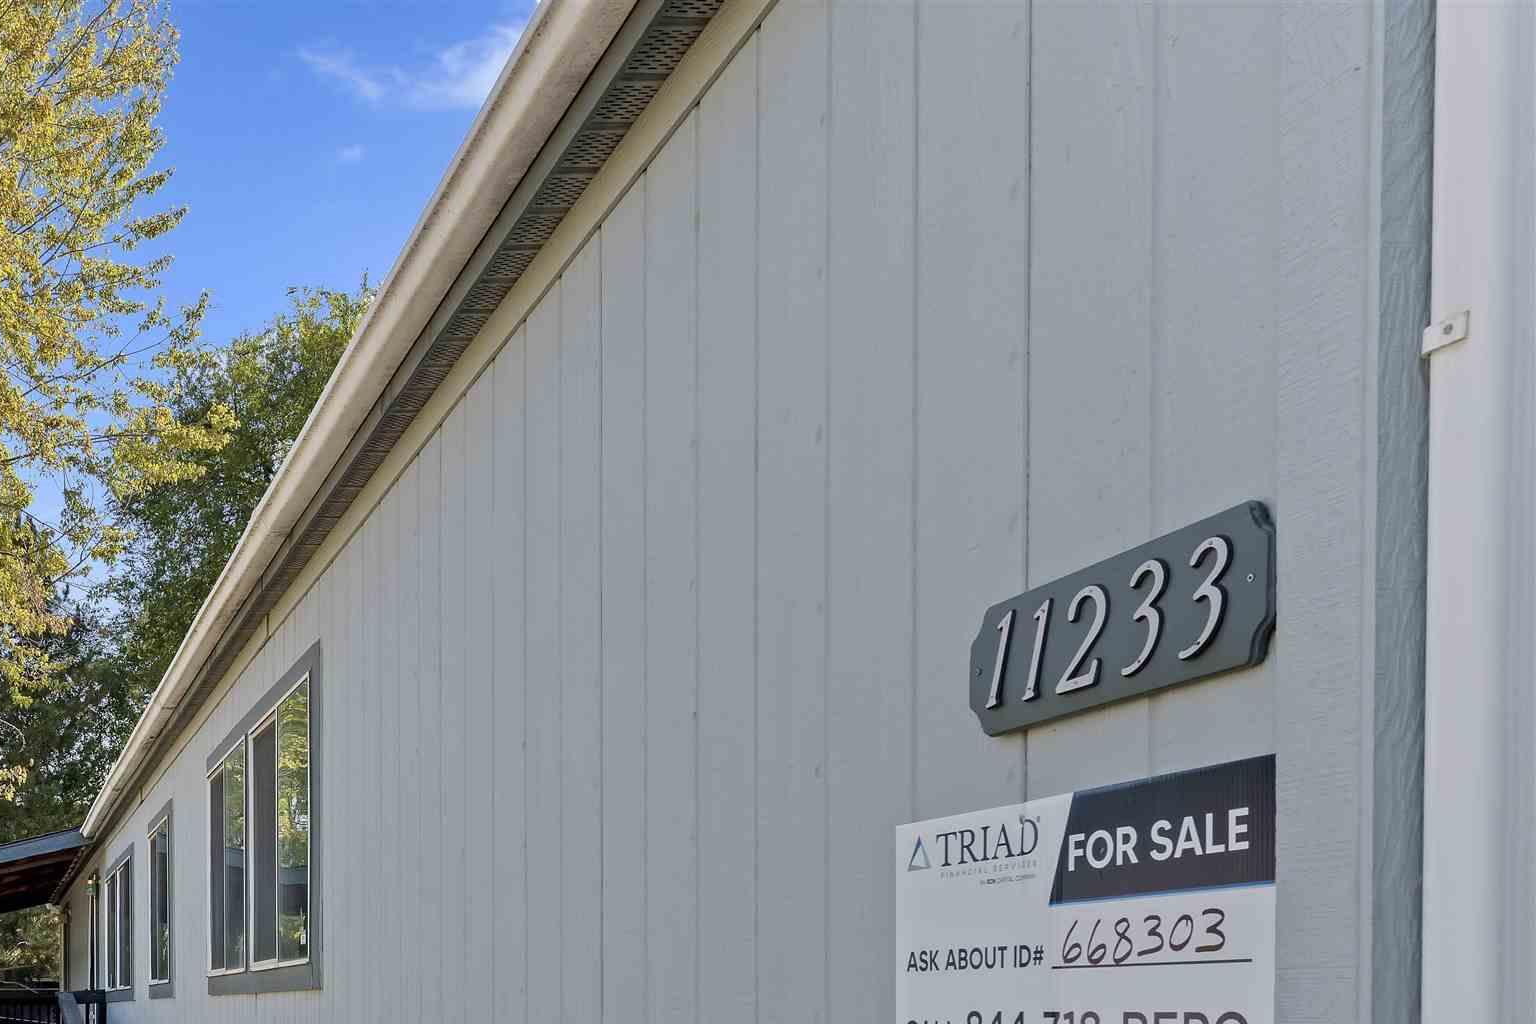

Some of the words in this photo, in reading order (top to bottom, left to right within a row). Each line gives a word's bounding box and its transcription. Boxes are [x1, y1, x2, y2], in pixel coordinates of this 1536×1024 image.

[985, 535, 1232, 711] 11233
[936, 819, 1039, 867] TRIAD
[1067, 826, 1139, 873] FOR
[1150, 806, 1250, 862] SALE
[906, 950, 939, 972] ASK
[945, 945, 1007, 970] ABOUT
[1013, 944, 1044, 968] ID#
[1062, 907, 1227, 966] 668303
